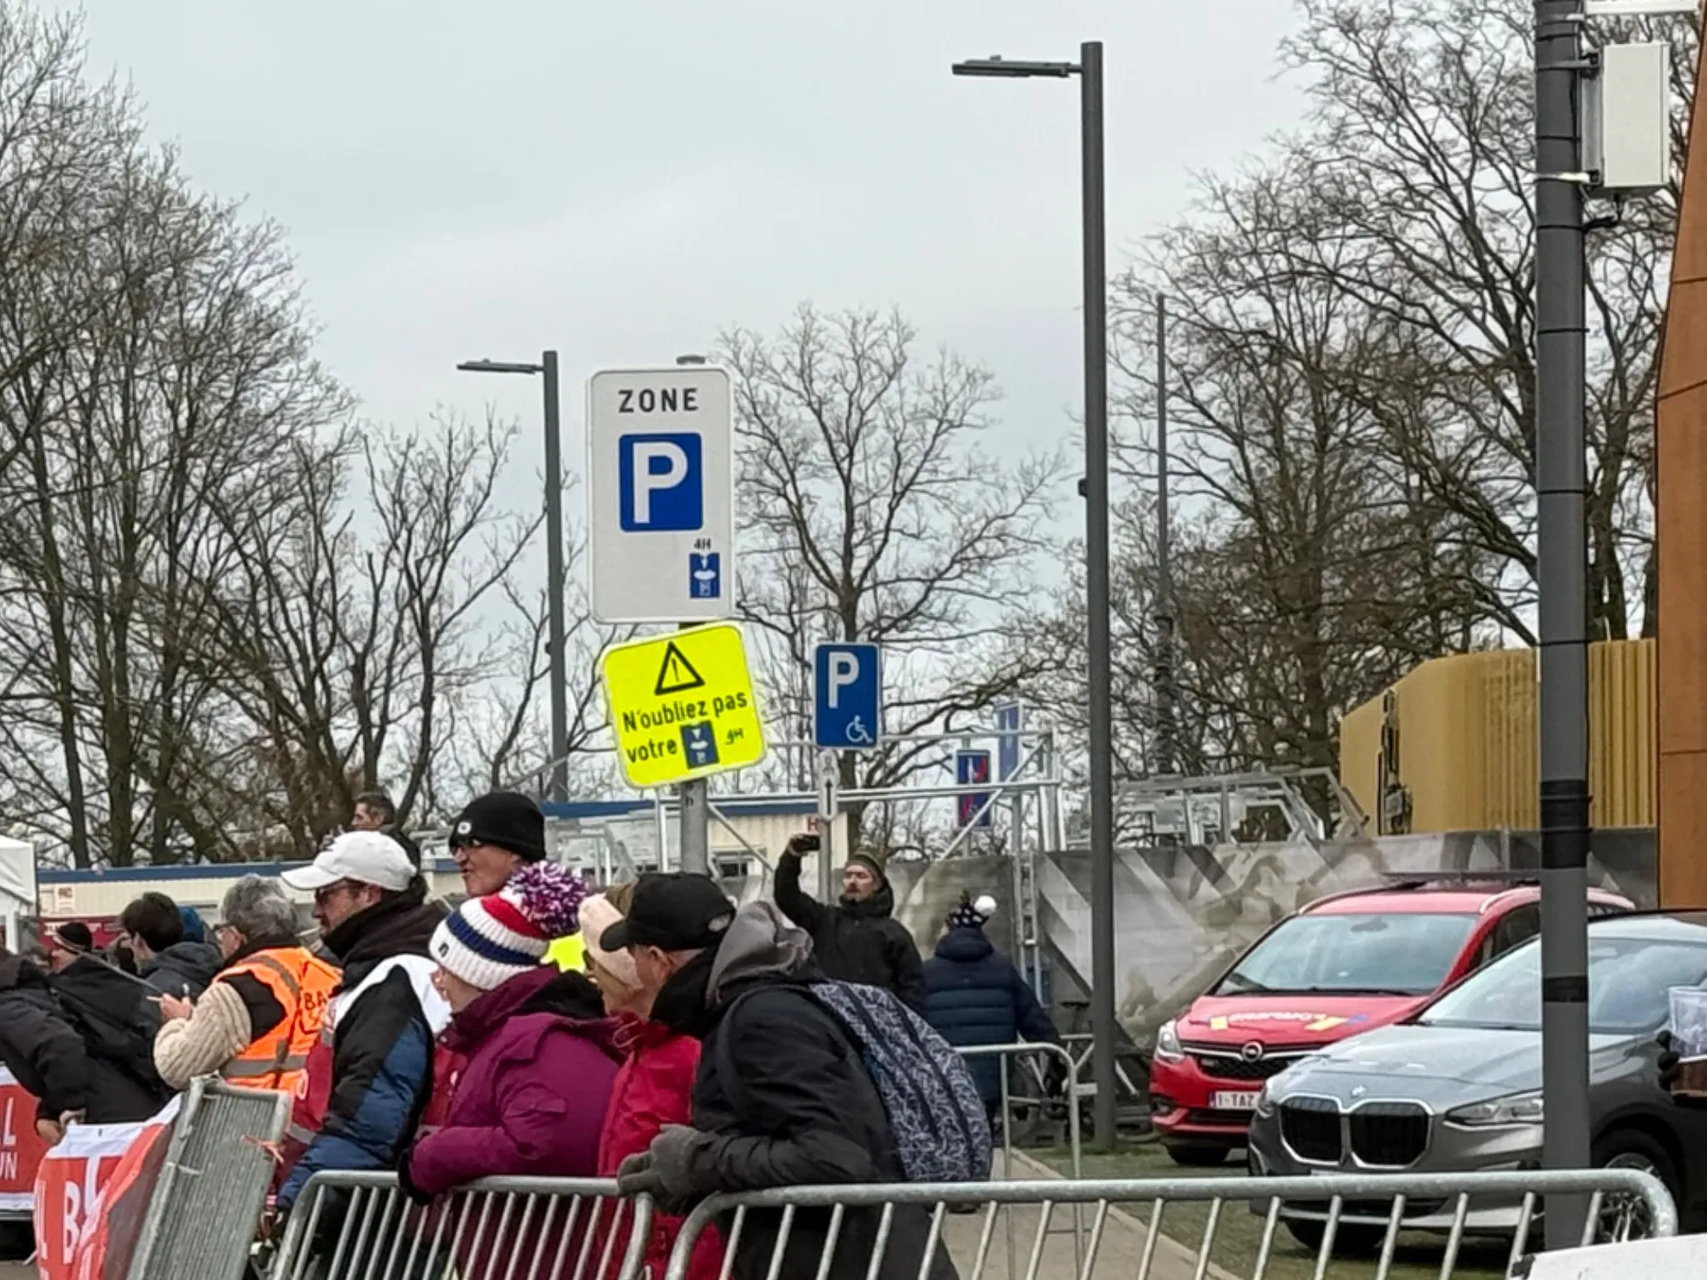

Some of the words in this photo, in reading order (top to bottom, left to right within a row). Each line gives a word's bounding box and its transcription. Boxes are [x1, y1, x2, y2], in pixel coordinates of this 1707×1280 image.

[618, 388, 699, 413] ZONE
[632, 441, 688, 524] P
[827, 652, 859, 708] P
[713, 692, 748, 718] pas
[627, 738, 678, 763] votre
